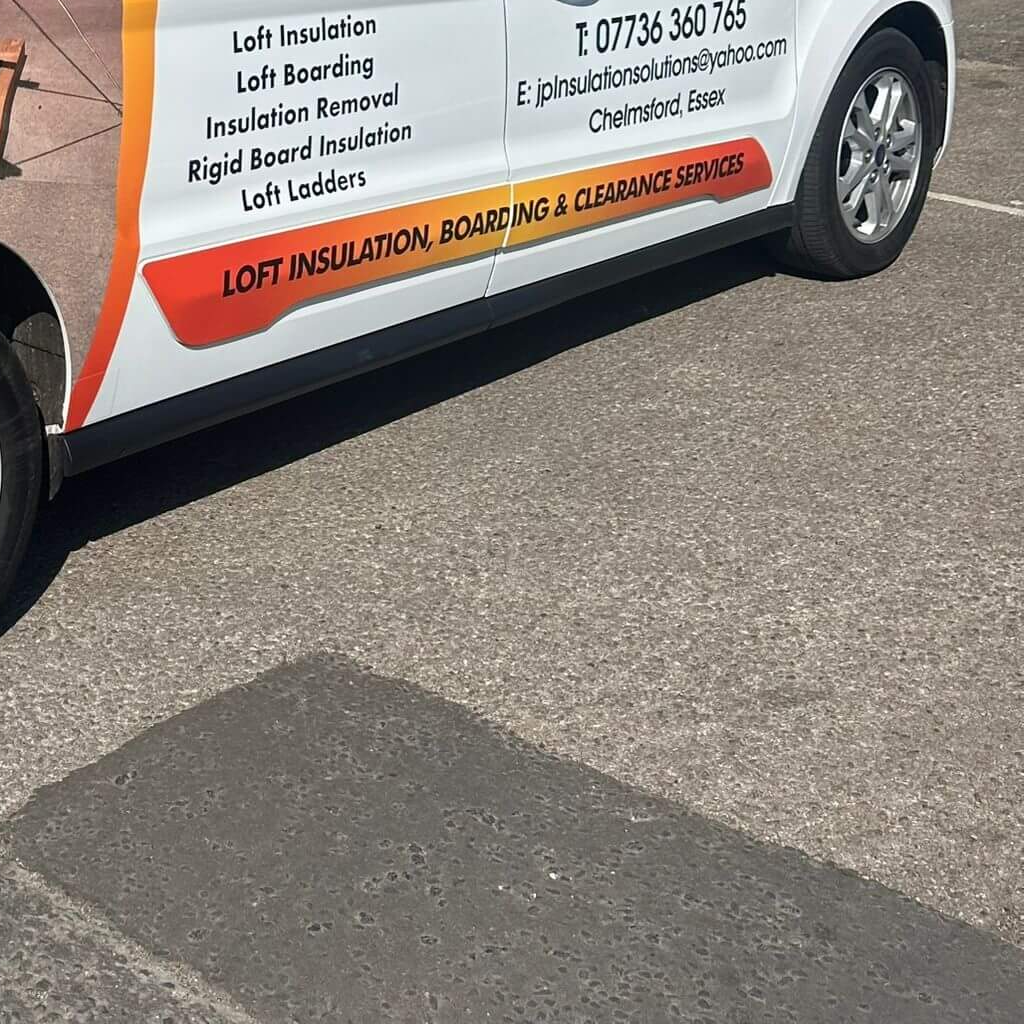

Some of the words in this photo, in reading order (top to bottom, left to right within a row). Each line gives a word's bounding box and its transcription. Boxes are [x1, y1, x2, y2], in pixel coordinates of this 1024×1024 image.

[232, 25, 274, 54] Loft
[280, 14, 377, 48] Insulation
[576, 21, 589, 57] T:
[596, 10, 663, 54] 07736
[669, 4, 707, 42] 360
[236, 65, 277, 94] Loft
[283, 53, 375, 88] Boarding
[517, 80, 531, 107] E:
[206, 102, 309, 140] Insulation
[315, 83, 399, 118] Removal
[589, 91, 683, 133] Chelmsford,
[687, 86, 726, 113] Essex
[187, 149, 243, 184] Rigid
[250, 136, 313, 172] Board
[319, 120, 412, 159] Insulation
[241, 182, 283, 212] Loft
[289, 168, 367, 203] Ladders
[222, 257, 283, 298] LOFT
[288, 222, 433, 280] INSULATION,
[439, 196, 550, 248] BOARDING
[554, 193, 568, 217] &
[574, 166, 673, 213] CLEARANCE
[675, 152, 745, 189] SERVICES
